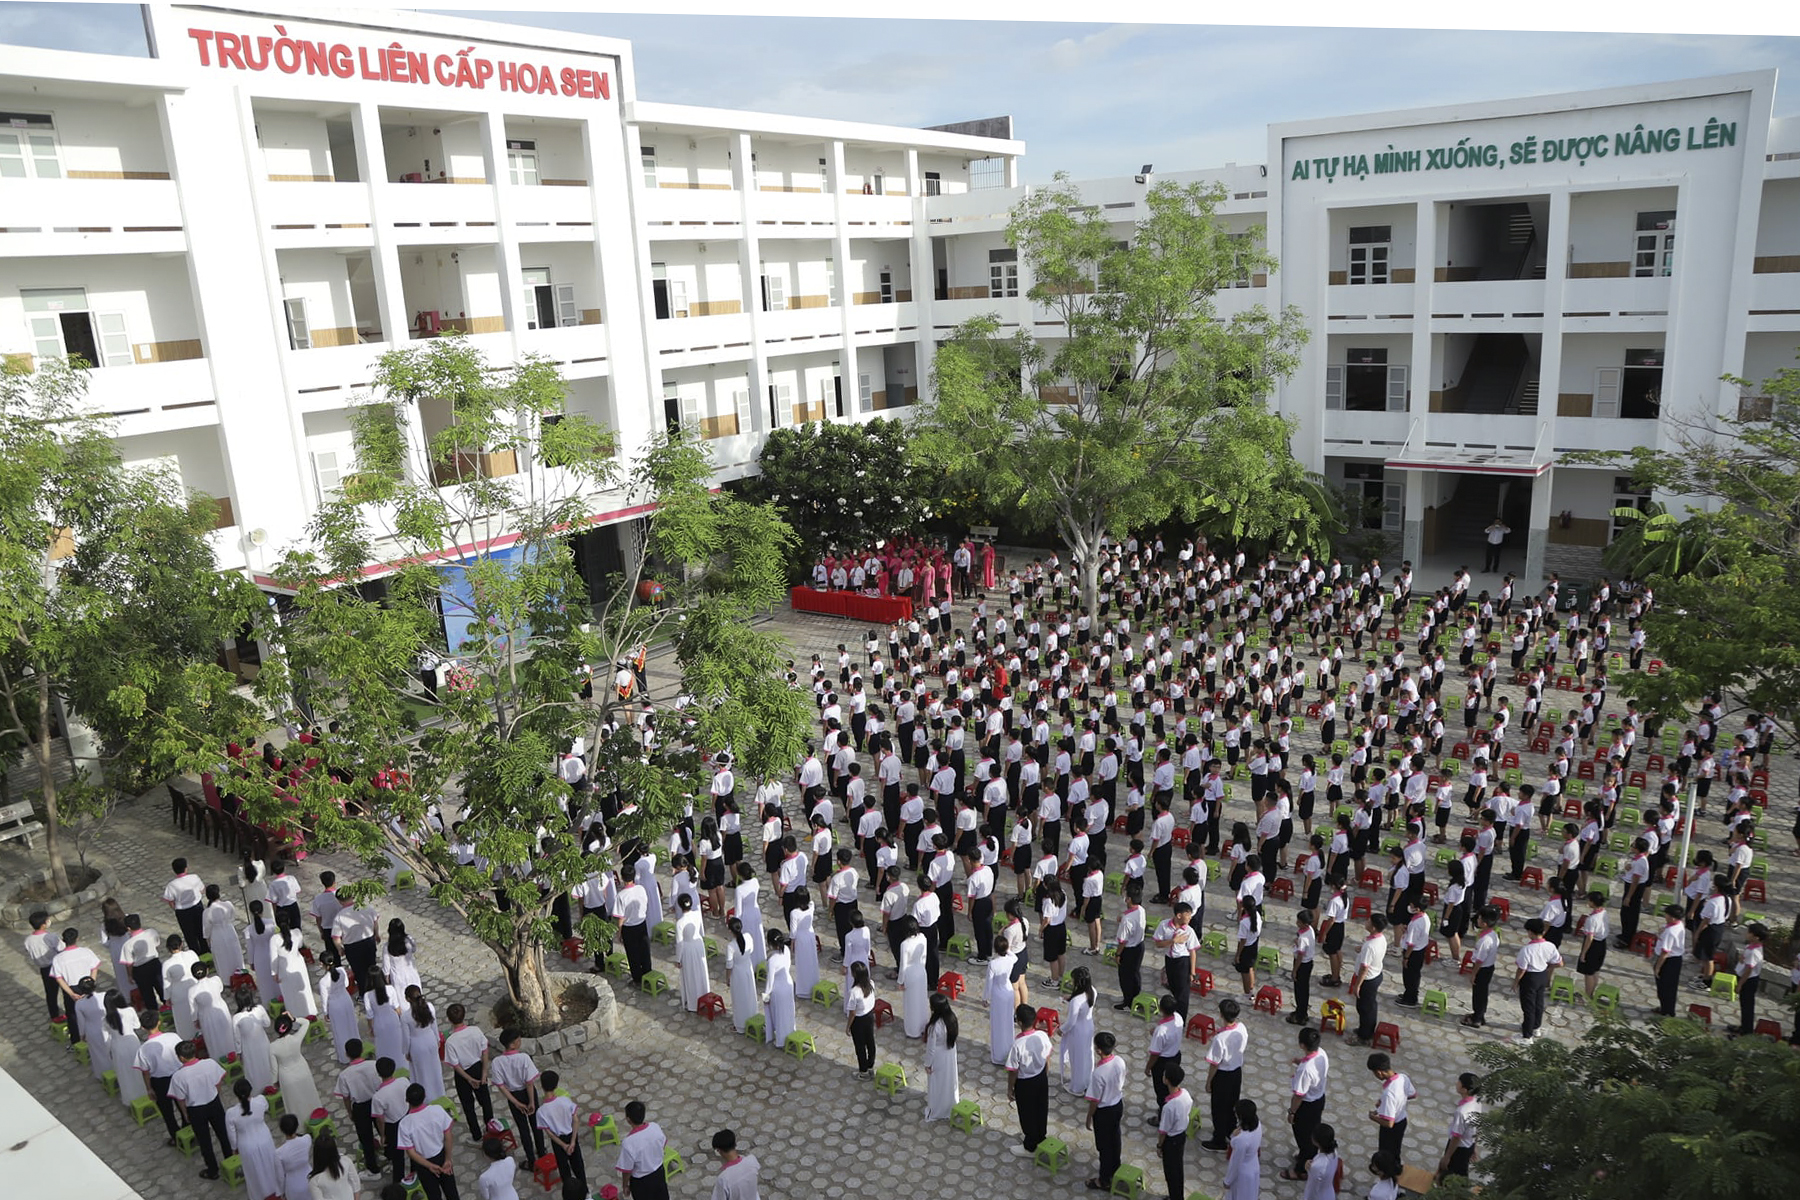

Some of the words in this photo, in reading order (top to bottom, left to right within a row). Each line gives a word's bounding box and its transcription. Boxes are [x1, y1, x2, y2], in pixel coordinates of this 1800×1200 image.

[188, 25, 355, 79] TRƯỜNG
[360, 42, 430, 84] LIÊN
[434, 46, 494, 89] CẤP
[499, 62, 558, 95] HOA
[561, 68, 610, 99] SEN
[1291, 160, 1310, 181] AI
[1312, 157, 1341, 183] TỰ
[1343, 154, 1370, 181] HẠ
[1373, 145, 1421, 174] MÌNH
[1425, 137, 1506, 170] XUỐNG,
[1509, 136, 1538, 165] SẼ
[1541, 134, 1609, 167] ĐƯỢC
[1614, 124, 1682, 156] NÂNG
[1687, 117, 1737, 151] LÊN
